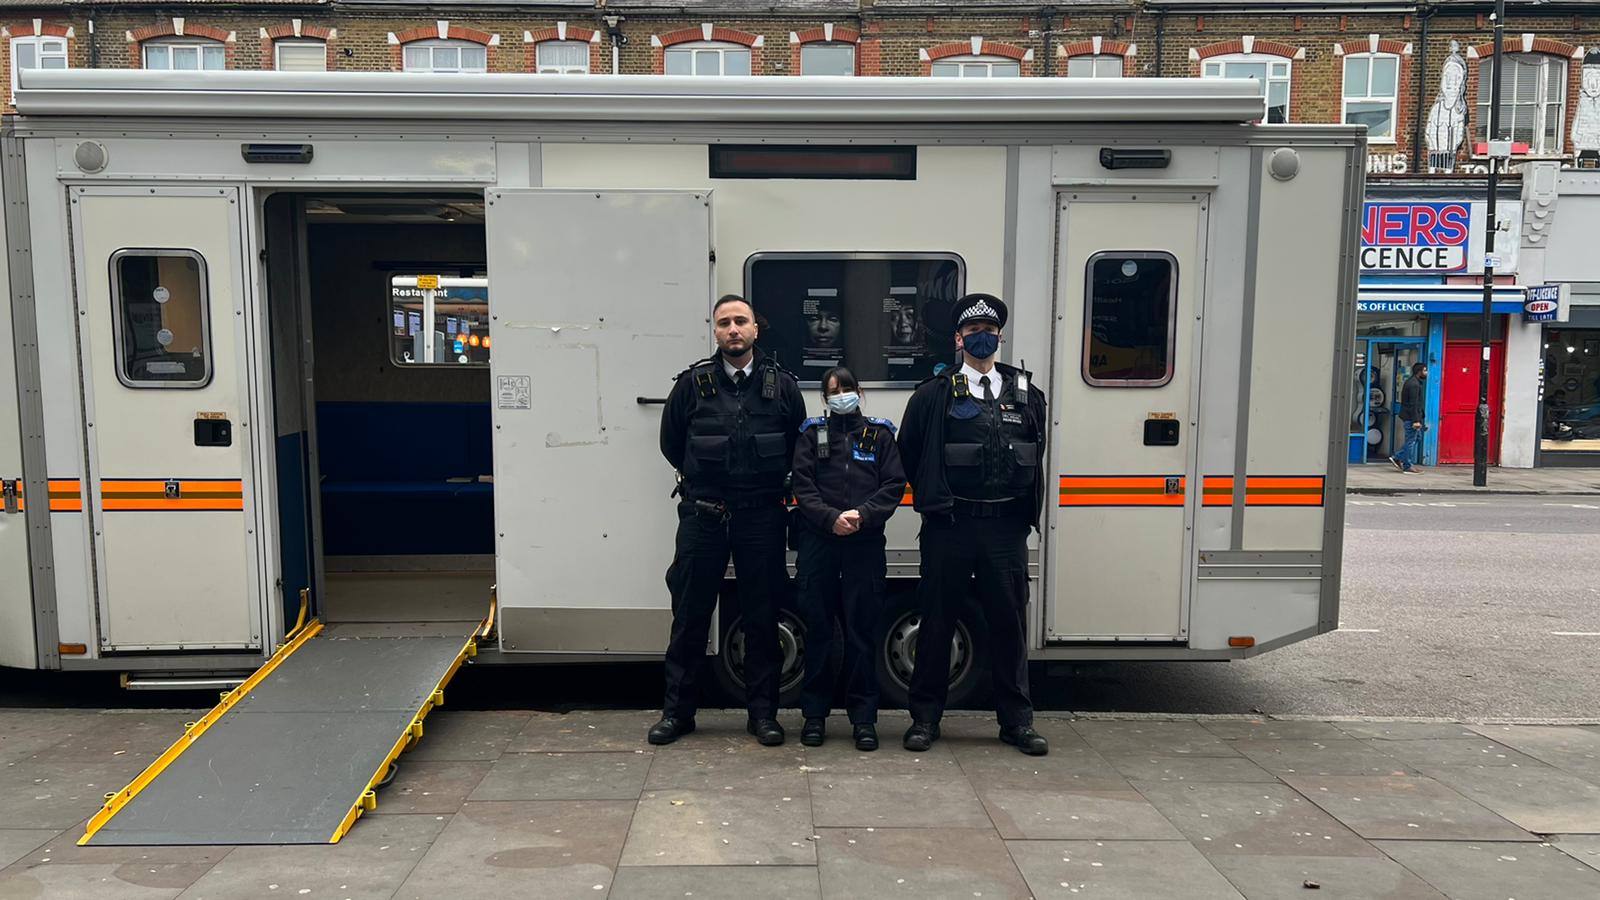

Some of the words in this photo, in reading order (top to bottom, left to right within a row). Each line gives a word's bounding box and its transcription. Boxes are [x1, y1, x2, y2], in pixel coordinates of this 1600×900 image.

[1361, 247, 1449, 269] CENCE
[1369, 302, 1387, 311] OFF
[1388, 302, 1425, 311] LICENCE
[1530, 302, 1550, 312] OPEN
